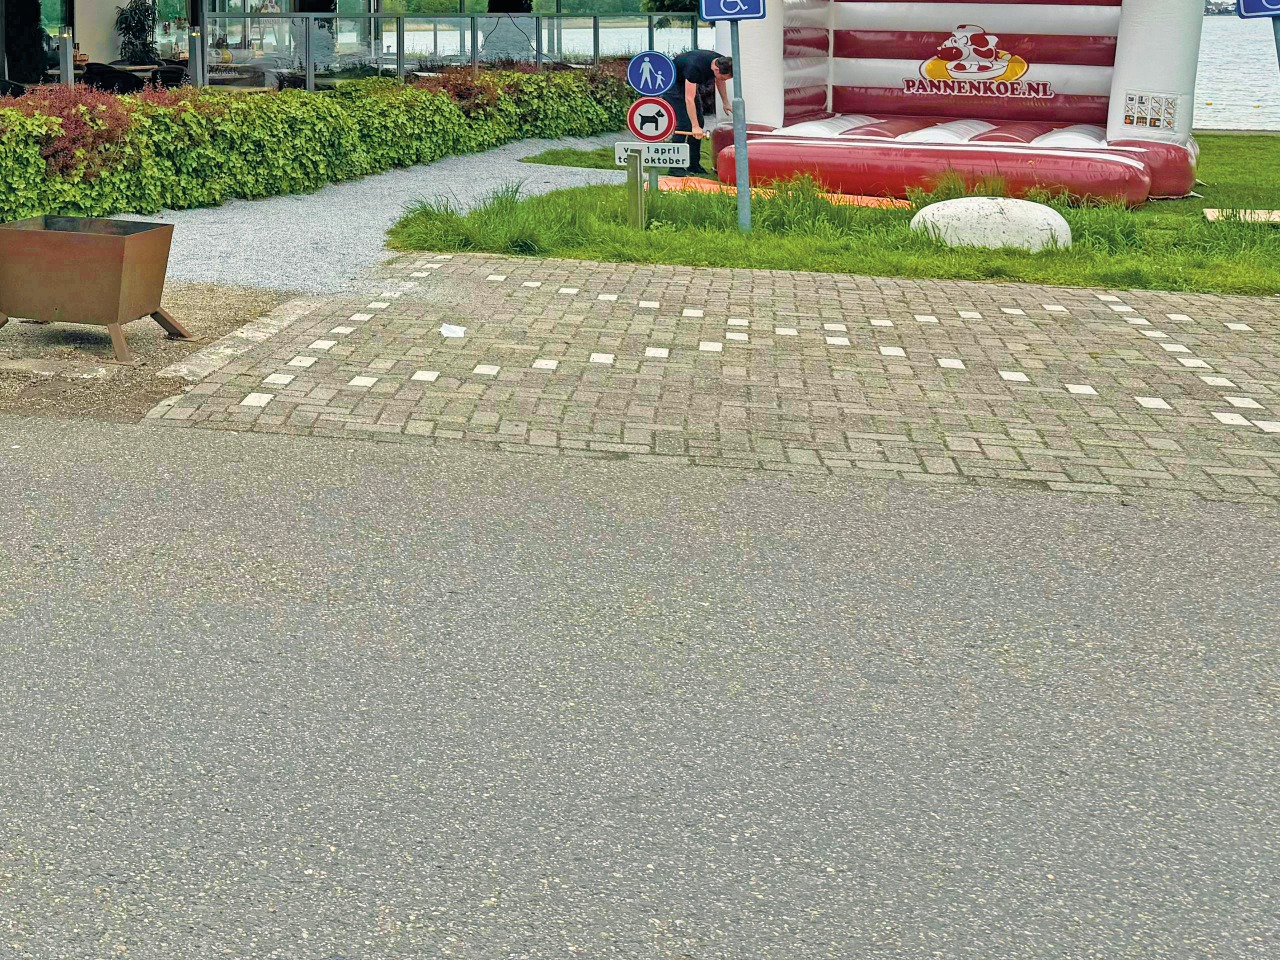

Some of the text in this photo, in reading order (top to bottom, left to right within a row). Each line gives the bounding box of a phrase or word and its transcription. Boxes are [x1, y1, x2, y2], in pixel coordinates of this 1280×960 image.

[904, 79, 1053, 97] PANNENKOE.NL
[654, 146, 680, 155] april
[644, 157, 687, 165] oktober
